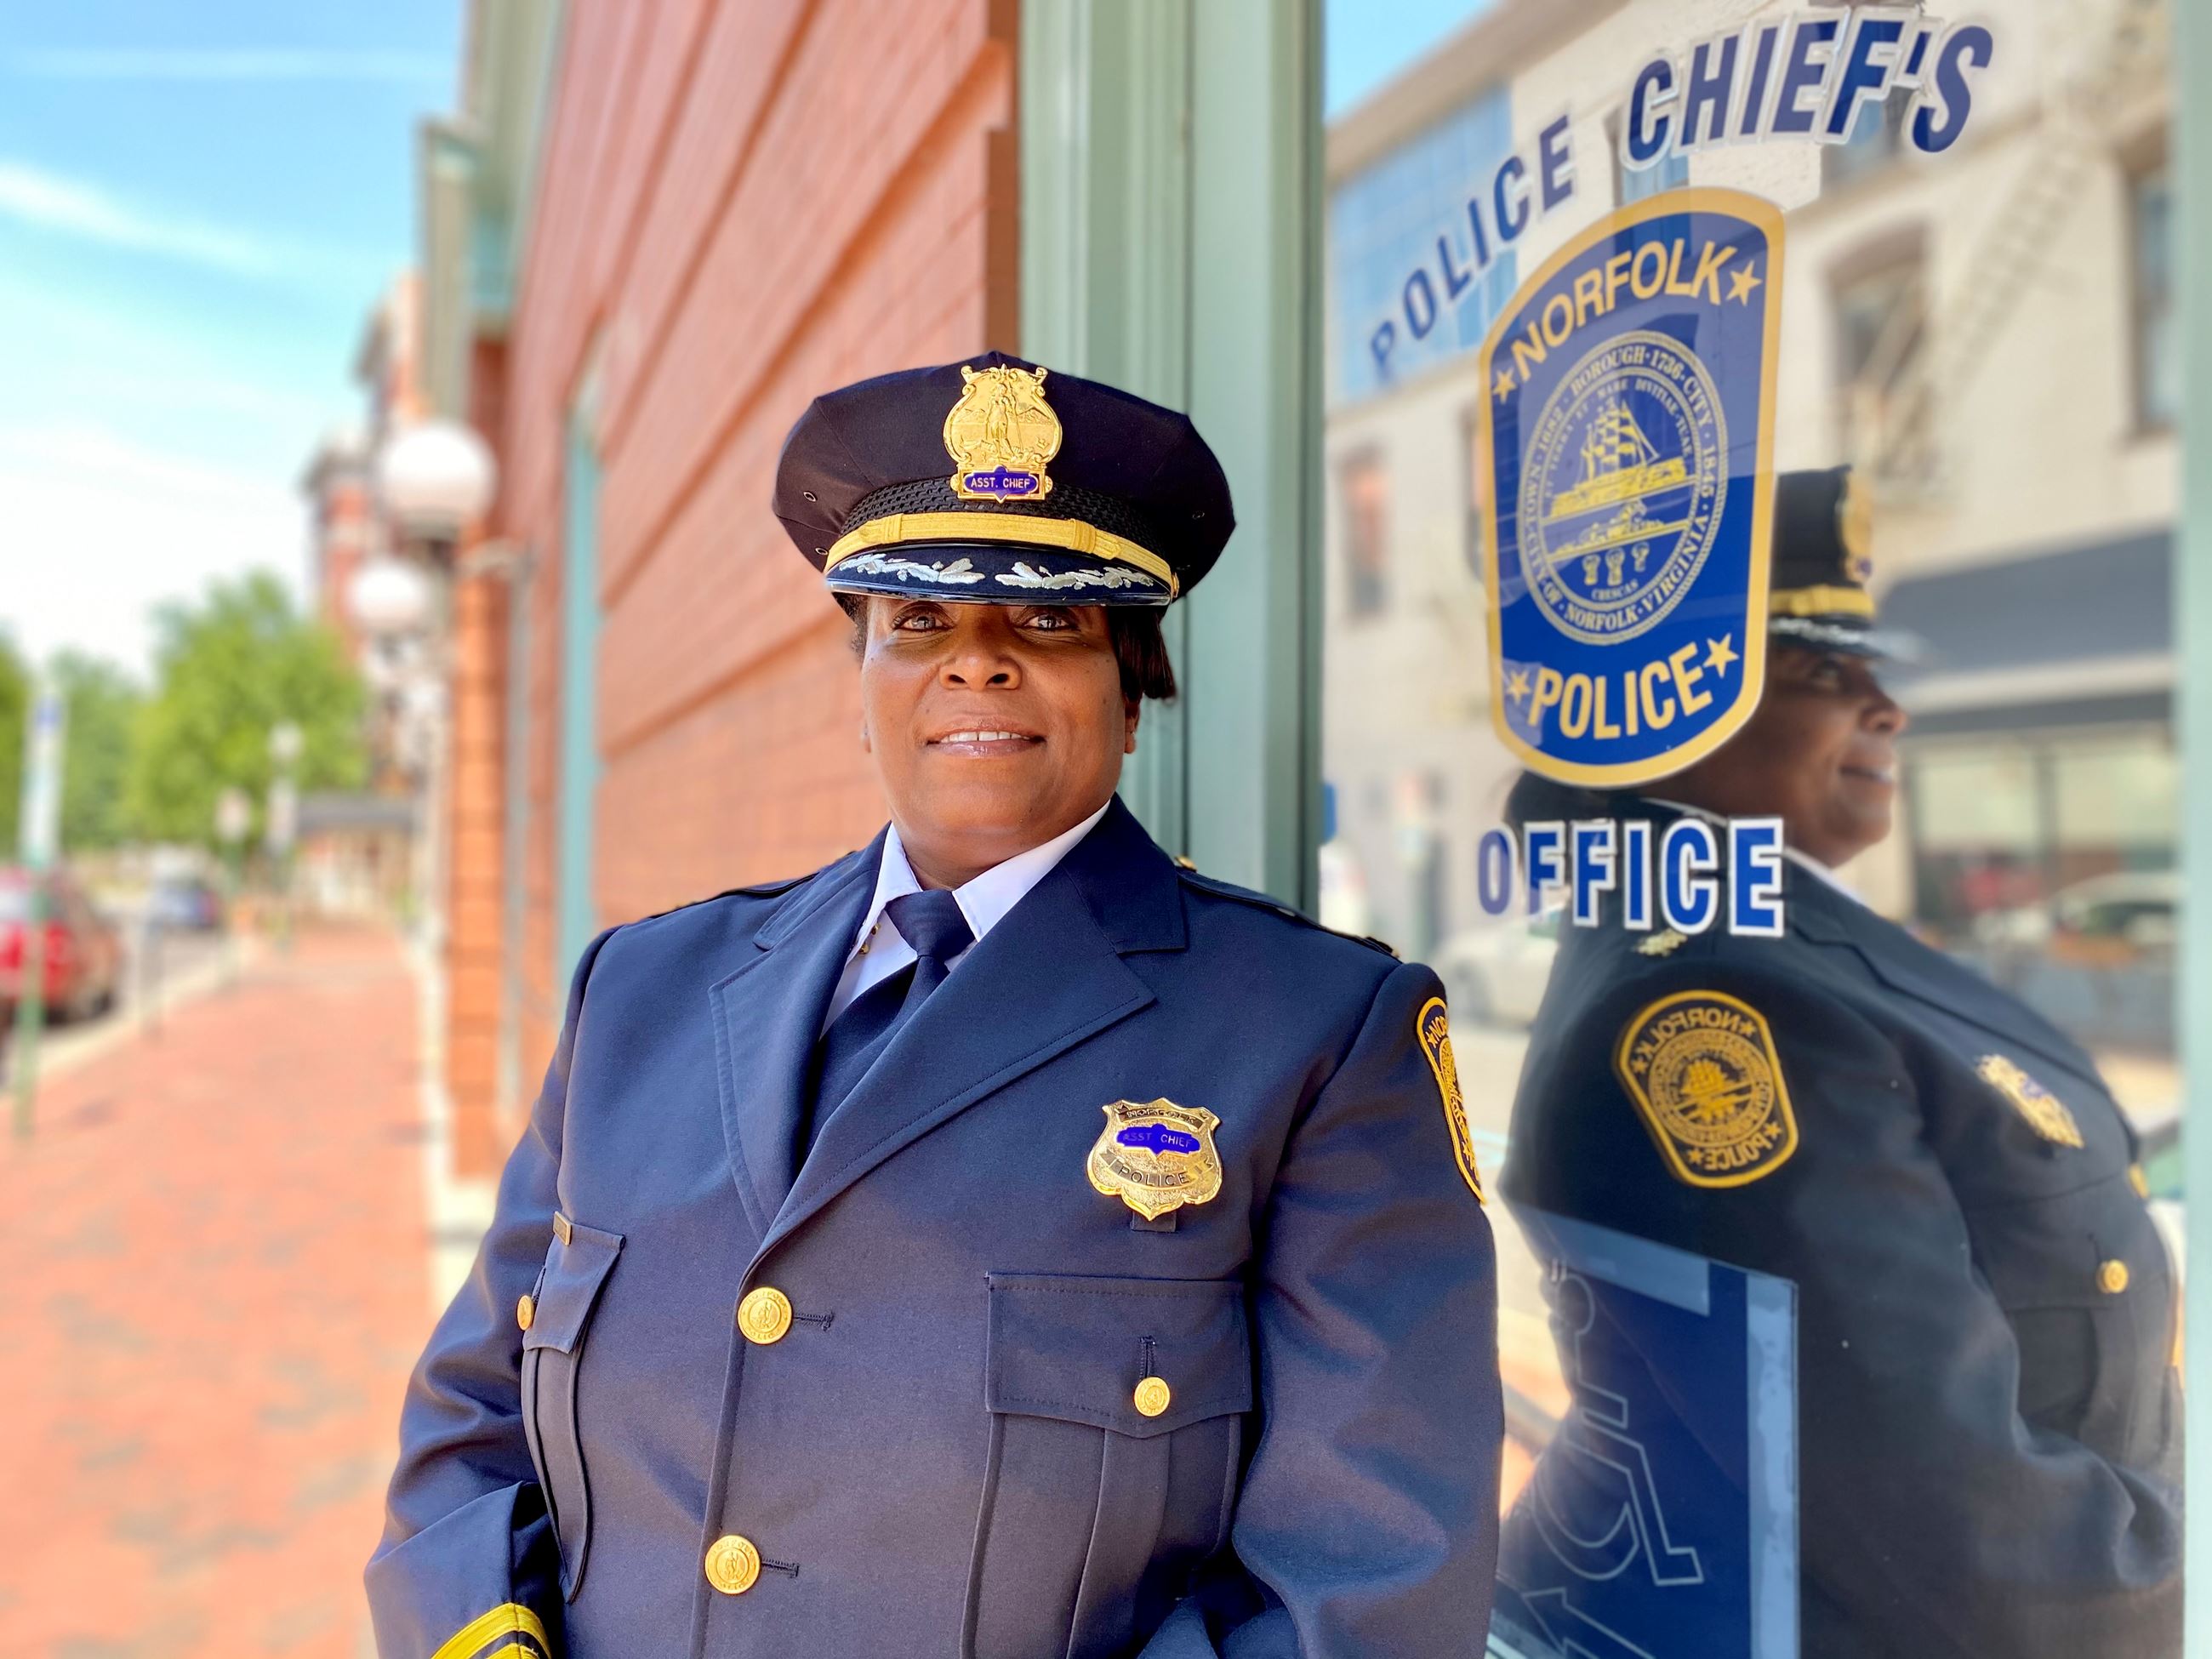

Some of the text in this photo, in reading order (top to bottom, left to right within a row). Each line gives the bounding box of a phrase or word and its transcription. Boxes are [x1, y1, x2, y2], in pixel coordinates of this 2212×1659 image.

[1371, 18, 1995, 379] POLICE CHIEF'S
[1511, 238, 1738, 382] NORFOLK
[1570, 346, 1646, 396] BOROUGH
[1650, 350, 1685, 380] 1736
[1683, 376, 1713, 428] CITY
[970, 477, 1031, 488] ASST. CHIEF
[1564, 602, 1639, 631] NORFOLK
[1642, 516, 1709, 612] VIRGINIA
[1527, 642, 1713, 740] POLICE
[1478, 819, 1782, 935] OFFICE
[1118, 1165, 1190, 1187] POLICE
[1160, 1133, 1192, 1149] CHIEF
